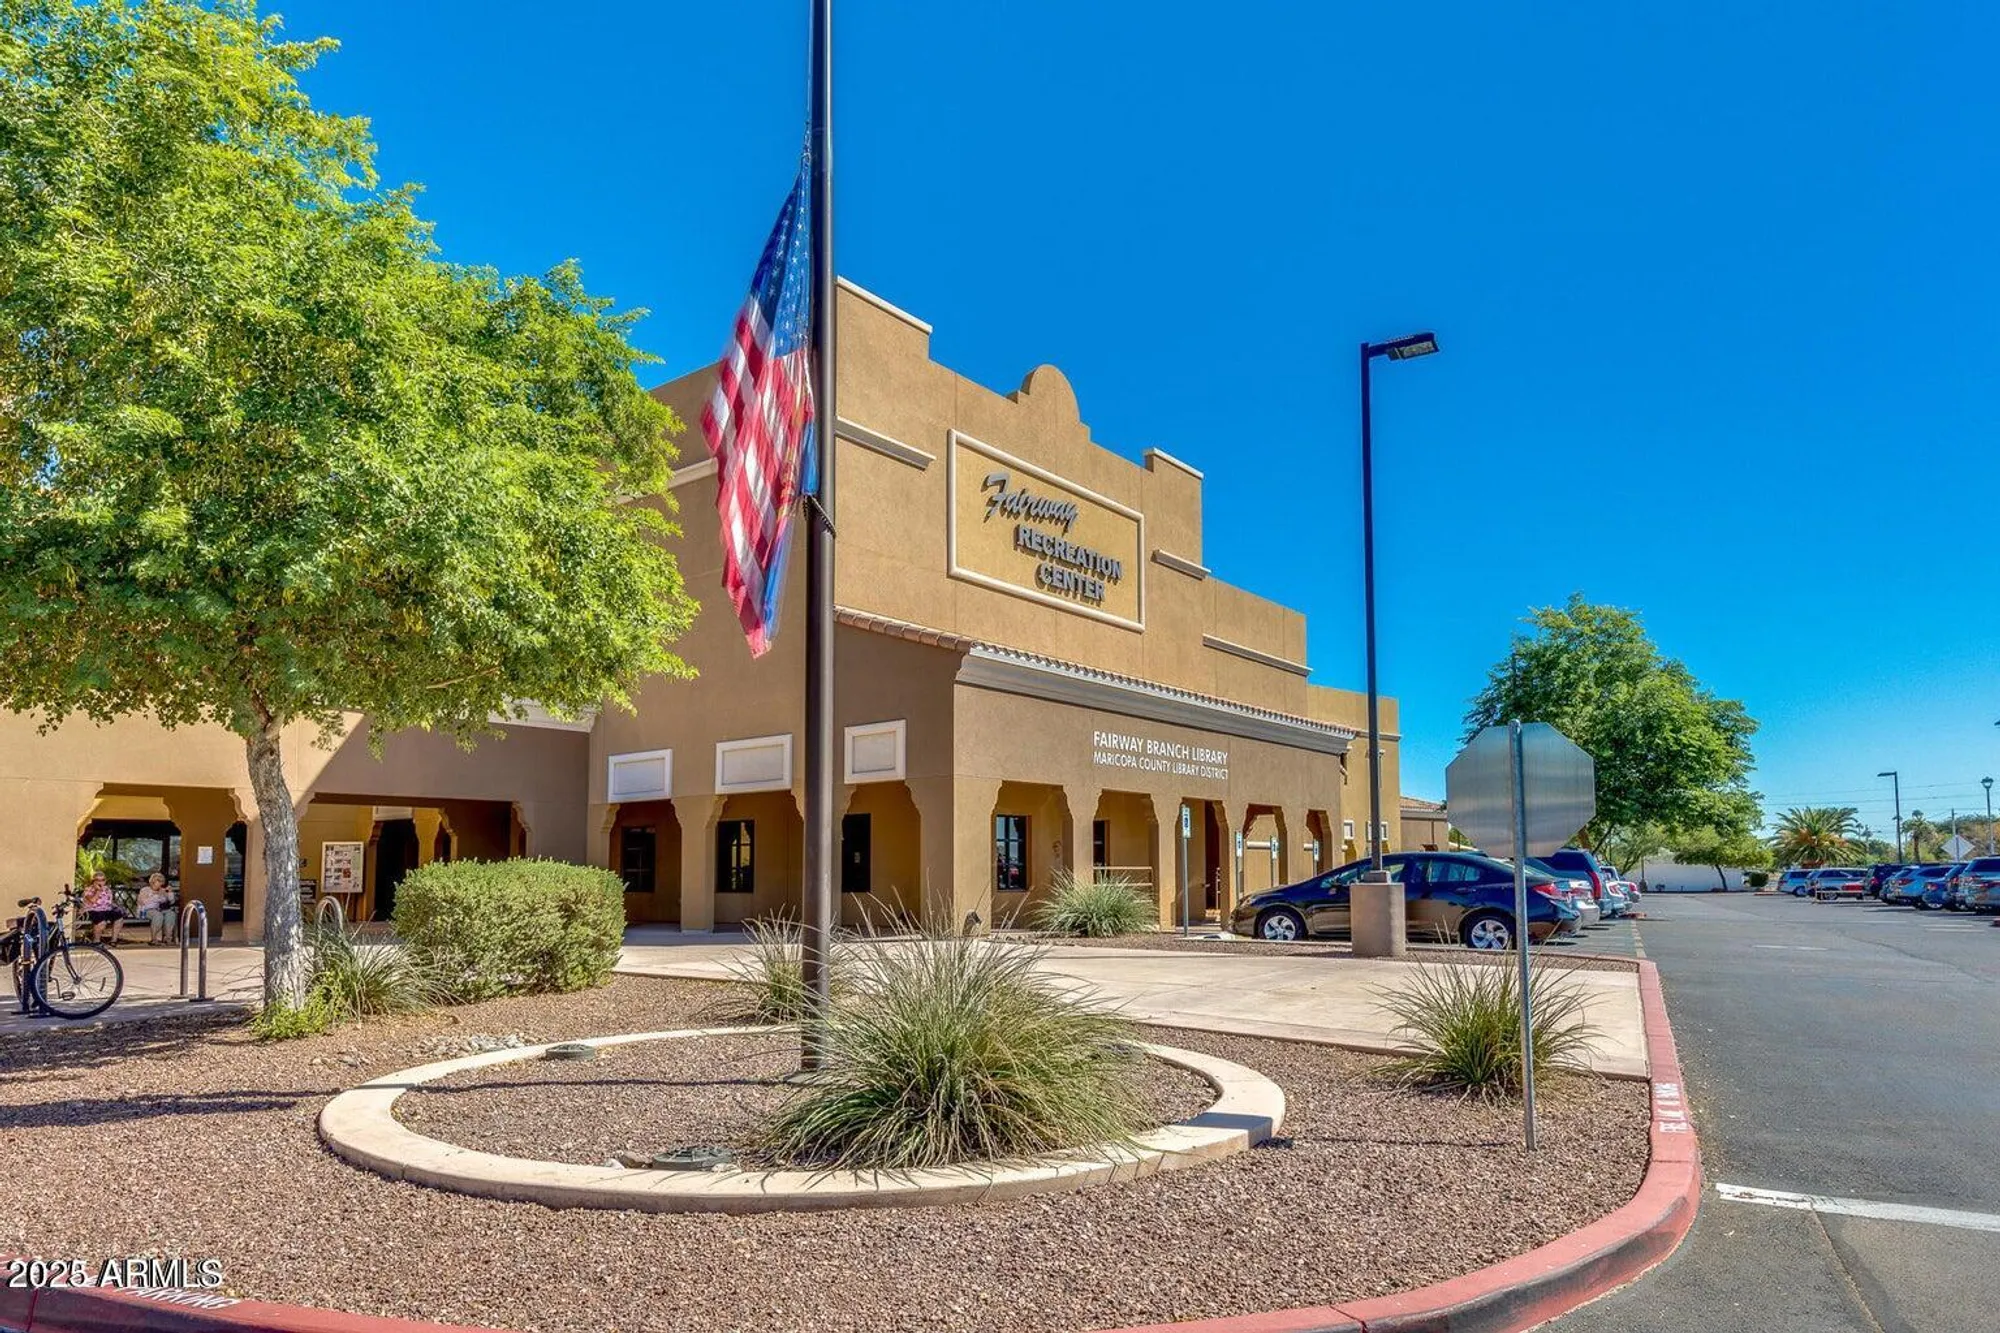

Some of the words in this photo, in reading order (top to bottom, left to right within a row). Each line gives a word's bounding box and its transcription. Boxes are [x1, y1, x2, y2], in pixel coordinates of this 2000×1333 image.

[981, 471, 1079, 532] Fairway
[1015, 524, 1122, 583] RECREATION
[1038, 562, 1105, 603] CENTER
[1093, 731, 1143, 753] FAIRWAY
[1147, 740, 1189, 759] BRANCH
[1192, 749, 1228, 765] LIBRARY
[1093, 752, 1137, 768] MARICOPA
[1139, 757, 1171, 772] COUNTY
[1172, 763, 1199, 776] LIBRARY
[1200, 766, 1228, 780] DISTRICT
